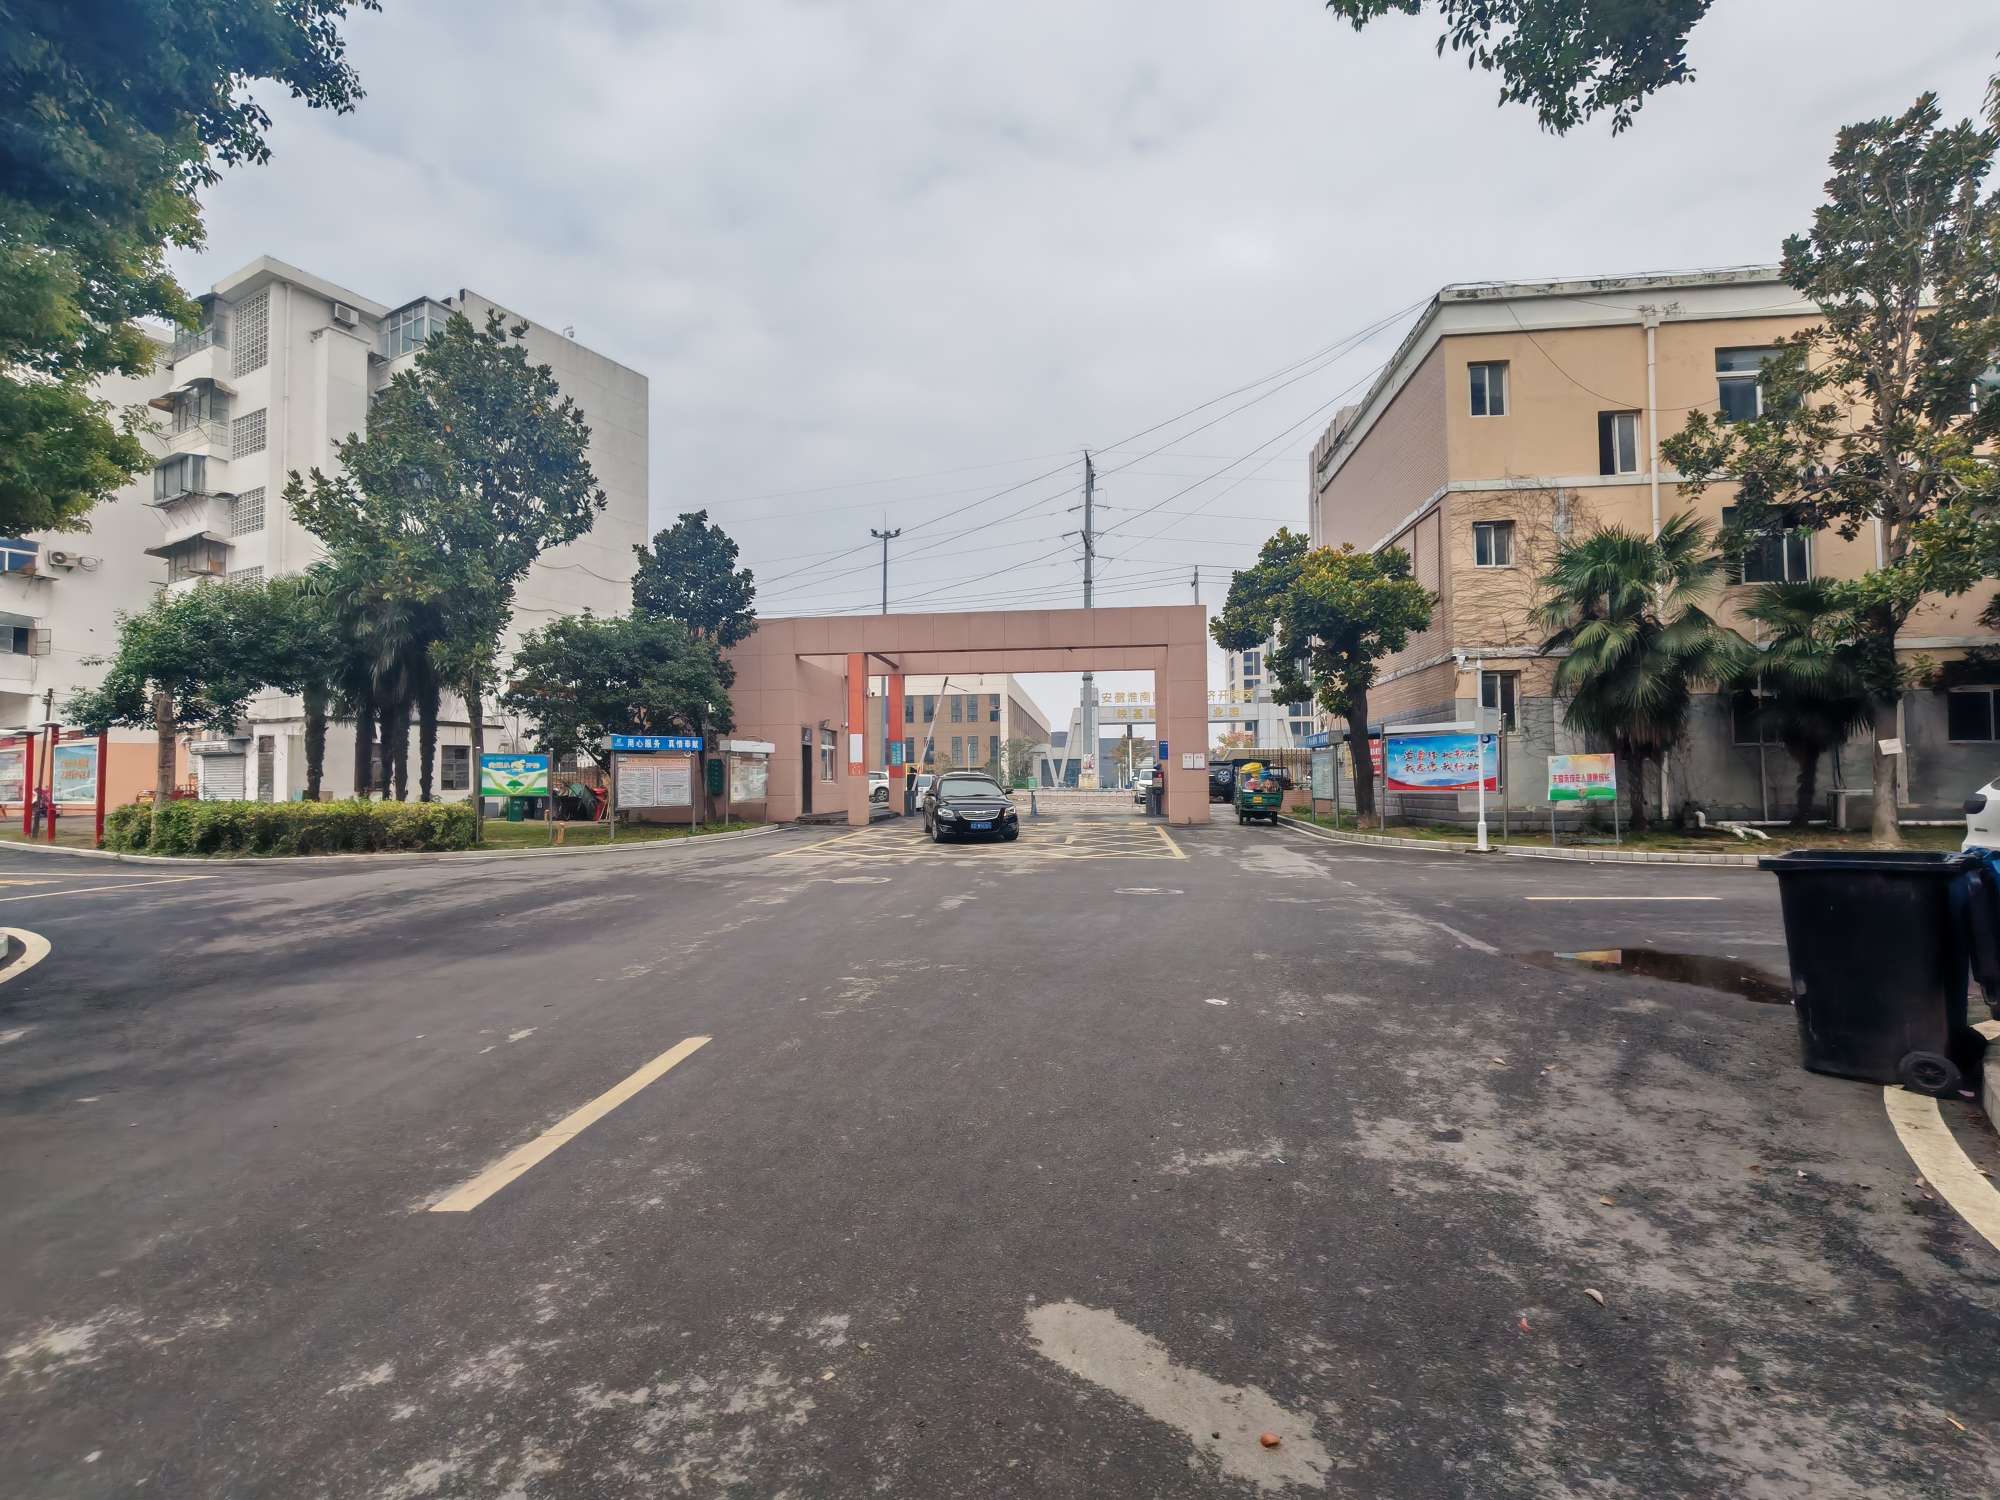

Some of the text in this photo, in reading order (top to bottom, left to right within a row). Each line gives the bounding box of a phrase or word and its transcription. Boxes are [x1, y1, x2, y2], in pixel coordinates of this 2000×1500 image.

[1101, 691, 1155, 704] 安徽淮南
[627, 738, 660, 749] 用心服务
[668, 739, 699, 749] 真情奉献
